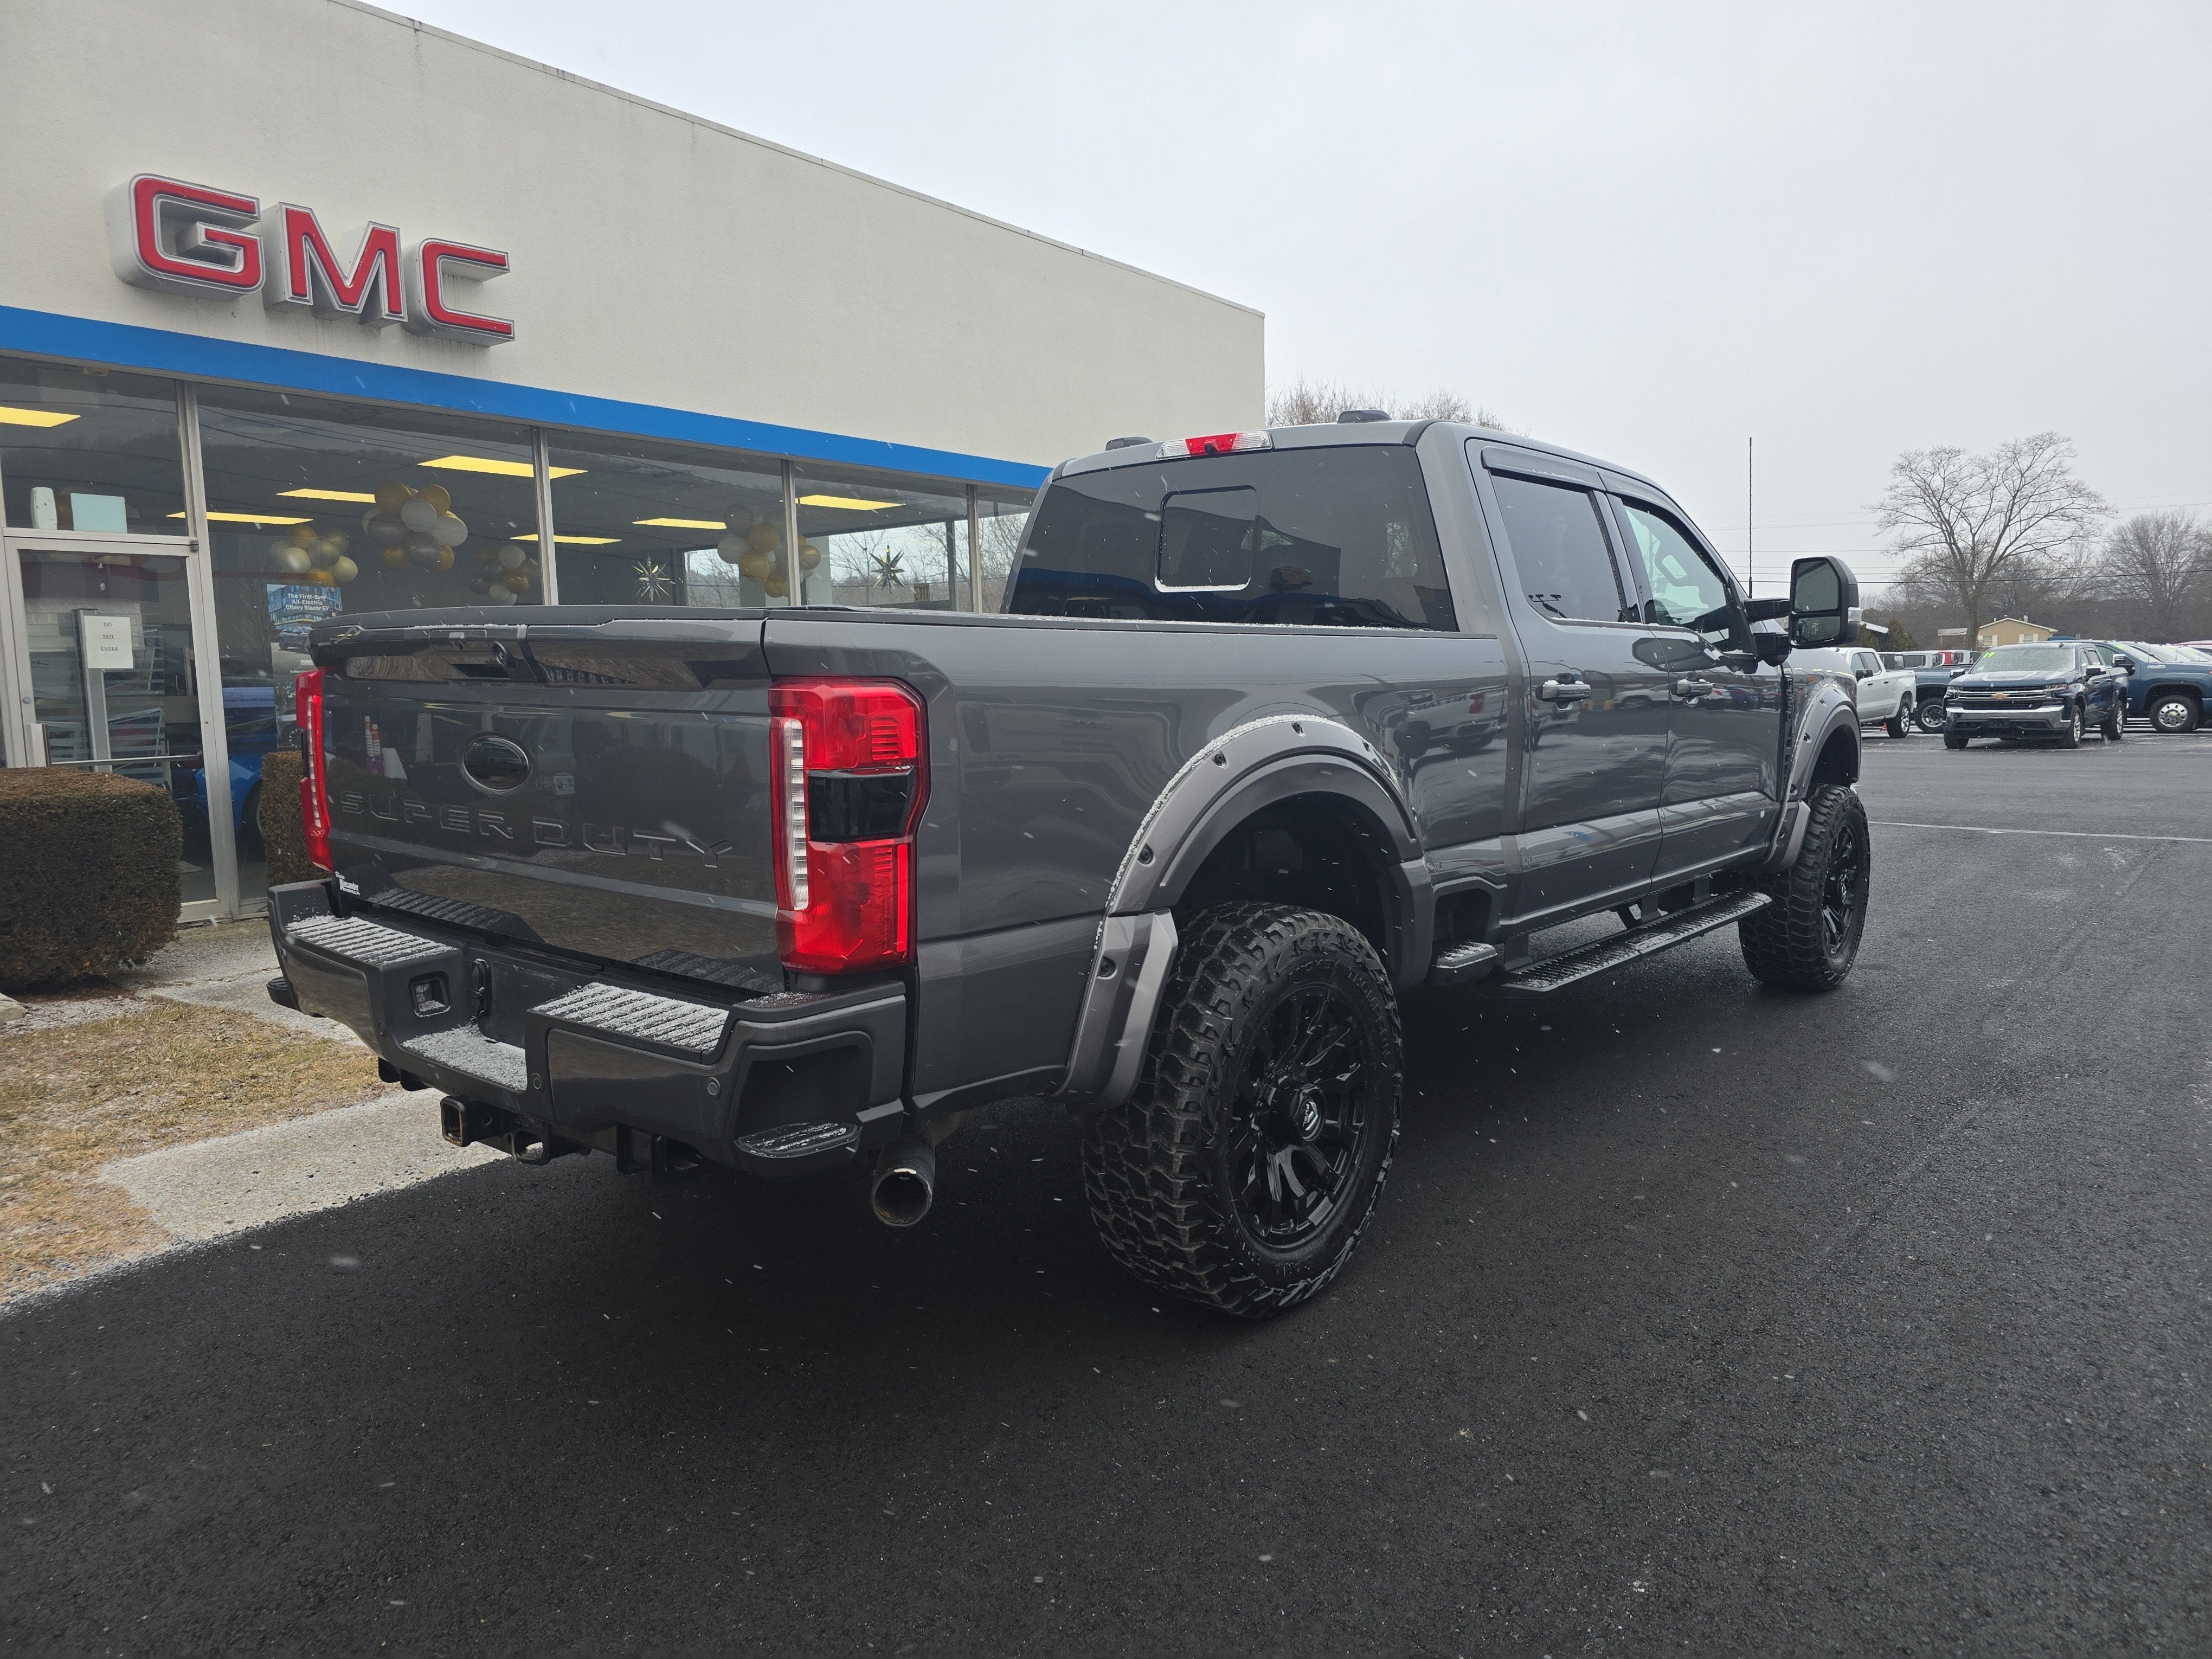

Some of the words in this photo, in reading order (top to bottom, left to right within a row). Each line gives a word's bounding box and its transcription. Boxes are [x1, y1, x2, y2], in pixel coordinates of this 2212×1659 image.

[128, 173, 515, 346] GMC
[341, 790, 513, 839] SUPER
[532, 816, 733, 867] DUTY
